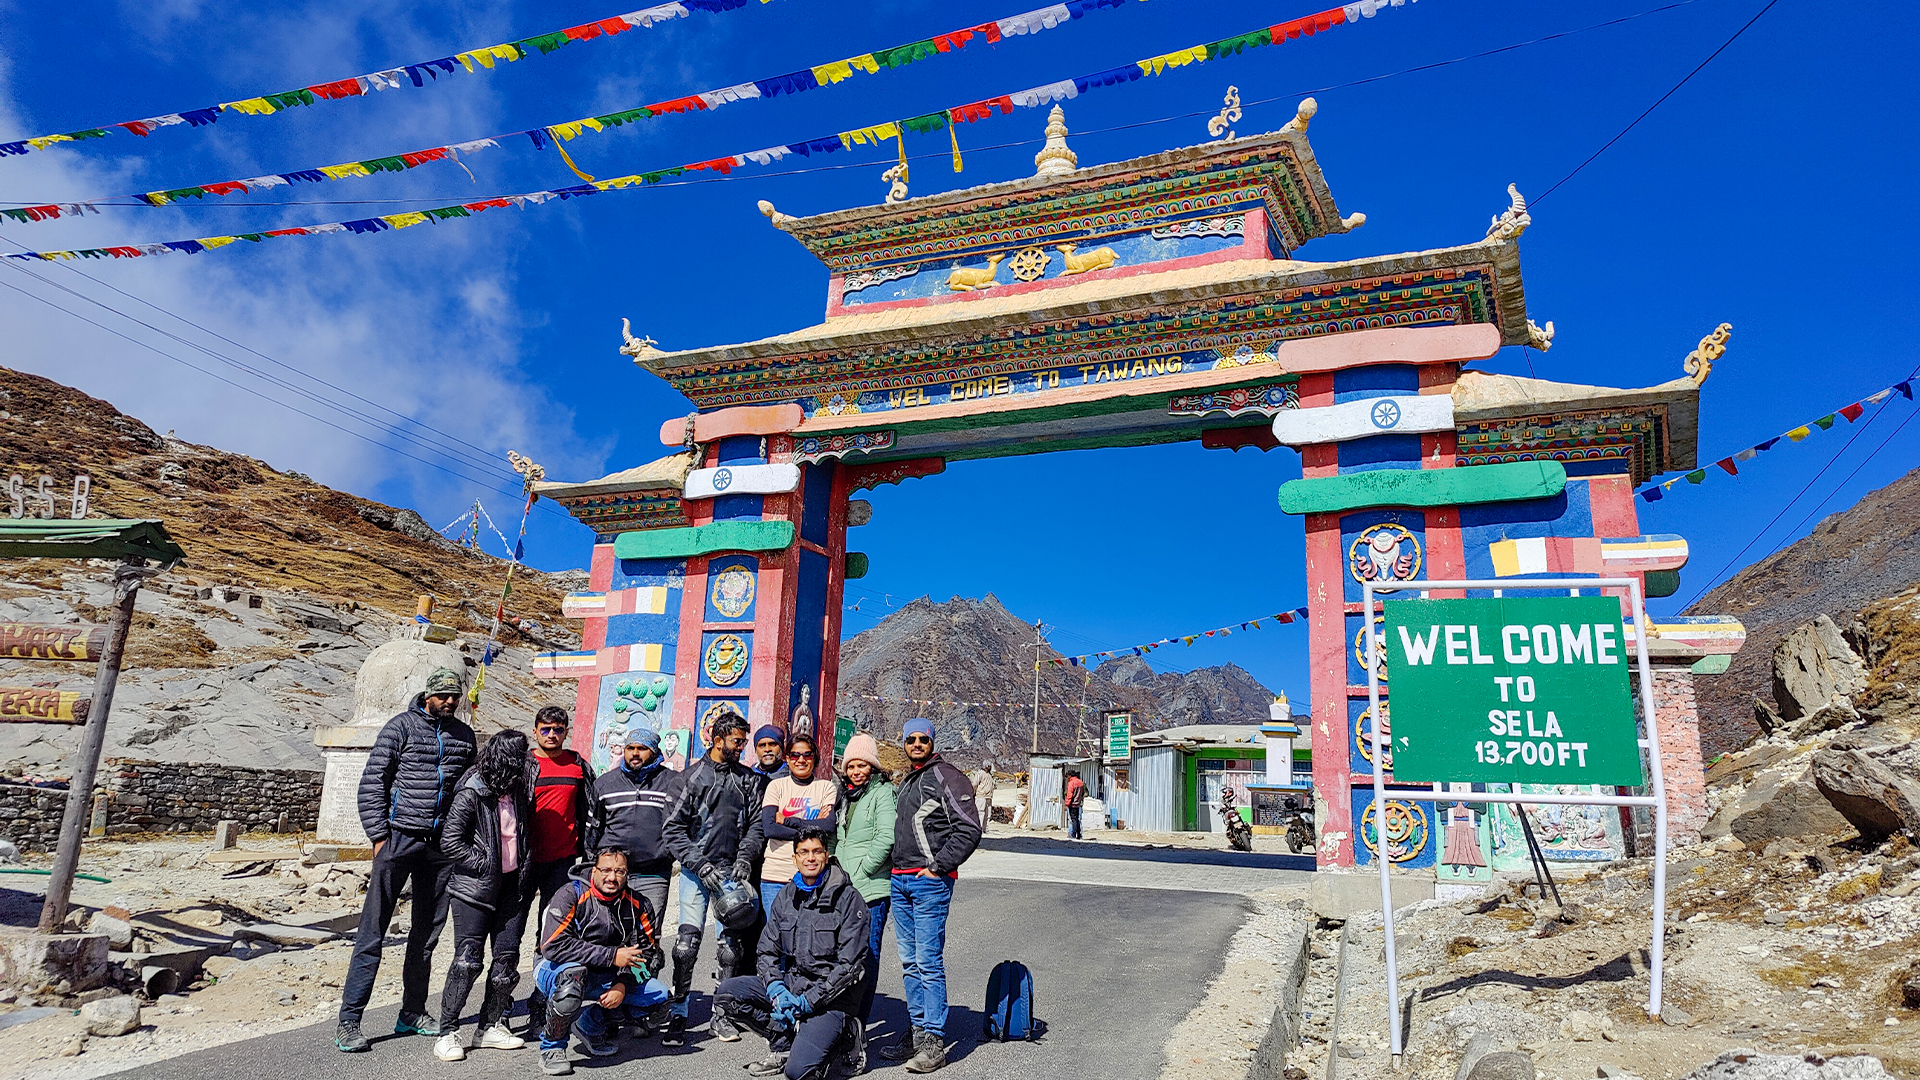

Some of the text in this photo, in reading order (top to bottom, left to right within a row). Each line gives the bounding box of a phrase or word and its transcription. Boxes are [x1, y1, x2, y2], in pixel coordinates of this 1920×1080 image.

[1032, 370, 1060, 390] TO
[1078, 356, 1182, 384] TAWANG
[1494, 675, 1536, 703] TO
[787, 797, 811, 808] NIKE
